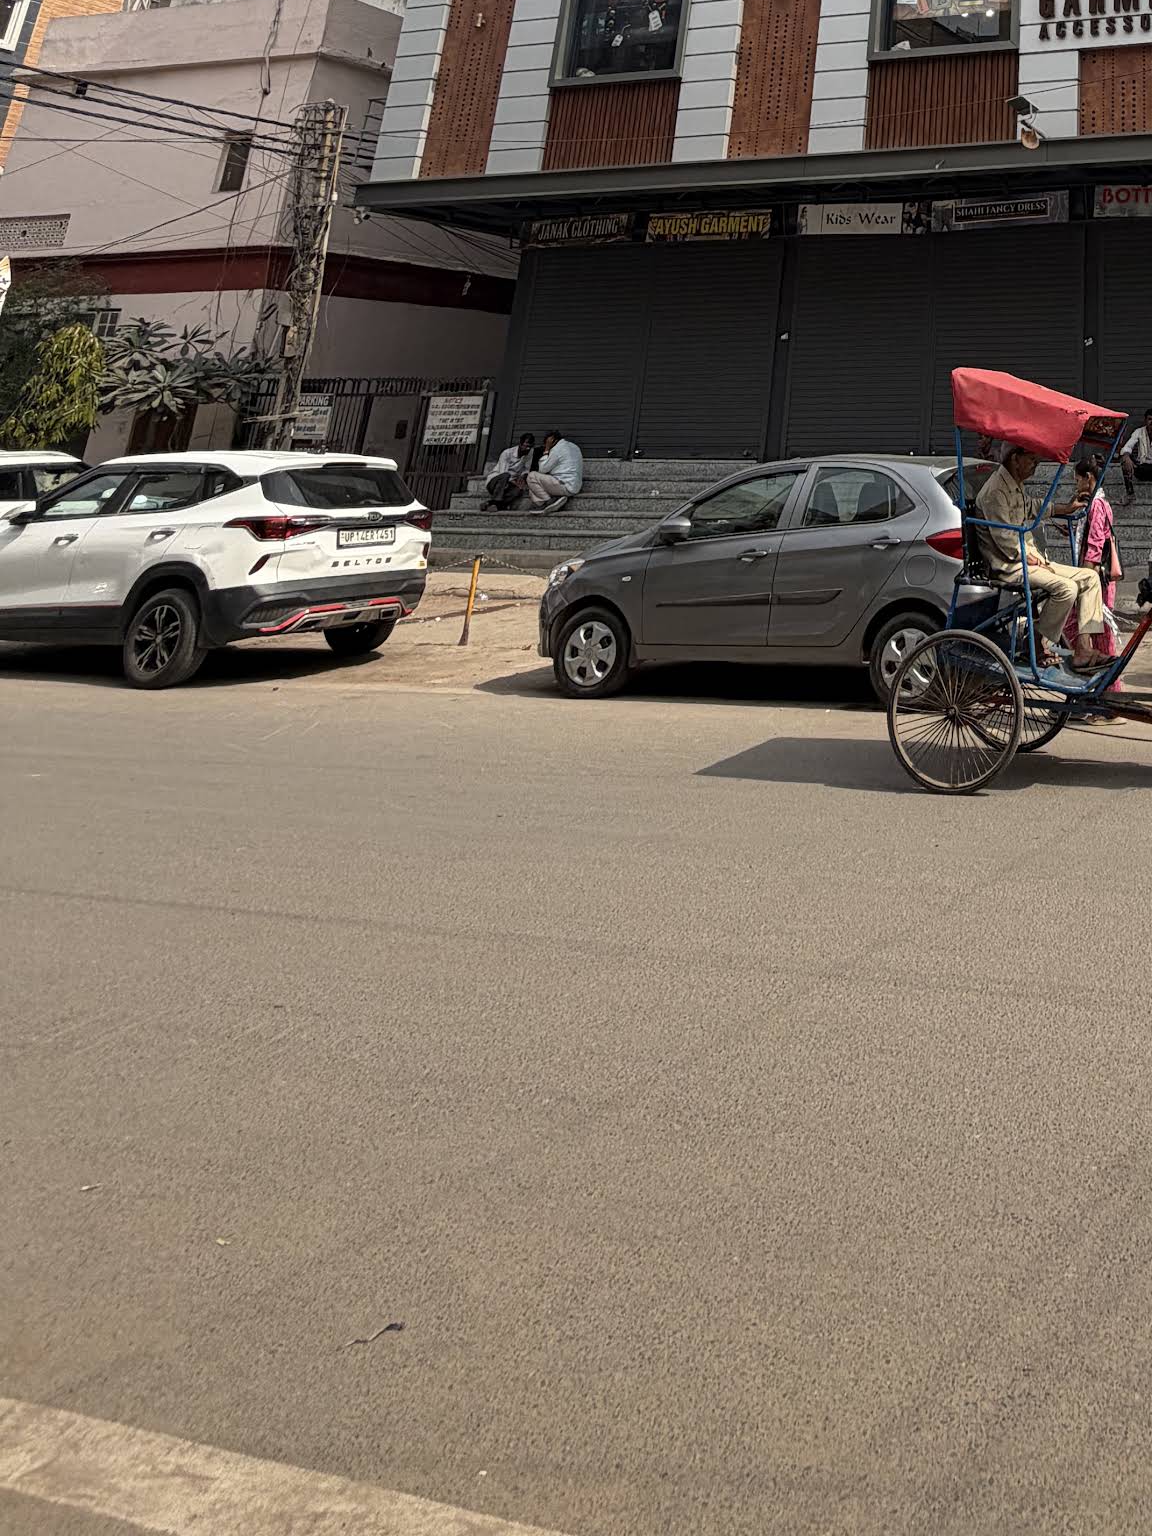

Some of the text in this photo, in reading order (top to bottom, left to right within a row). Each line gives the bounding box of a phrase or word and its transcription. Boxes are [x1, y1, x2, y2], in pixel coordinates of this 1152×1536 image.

[985, 204, 1016, 215] FANCY
[1017, 201, 1046, 211] DRESS
[655, 215, 764, 235] AYUSH GARMENT
[826, 212, 897, 225] Kids Wear
[331, 557, 392, 568] SELTOS
